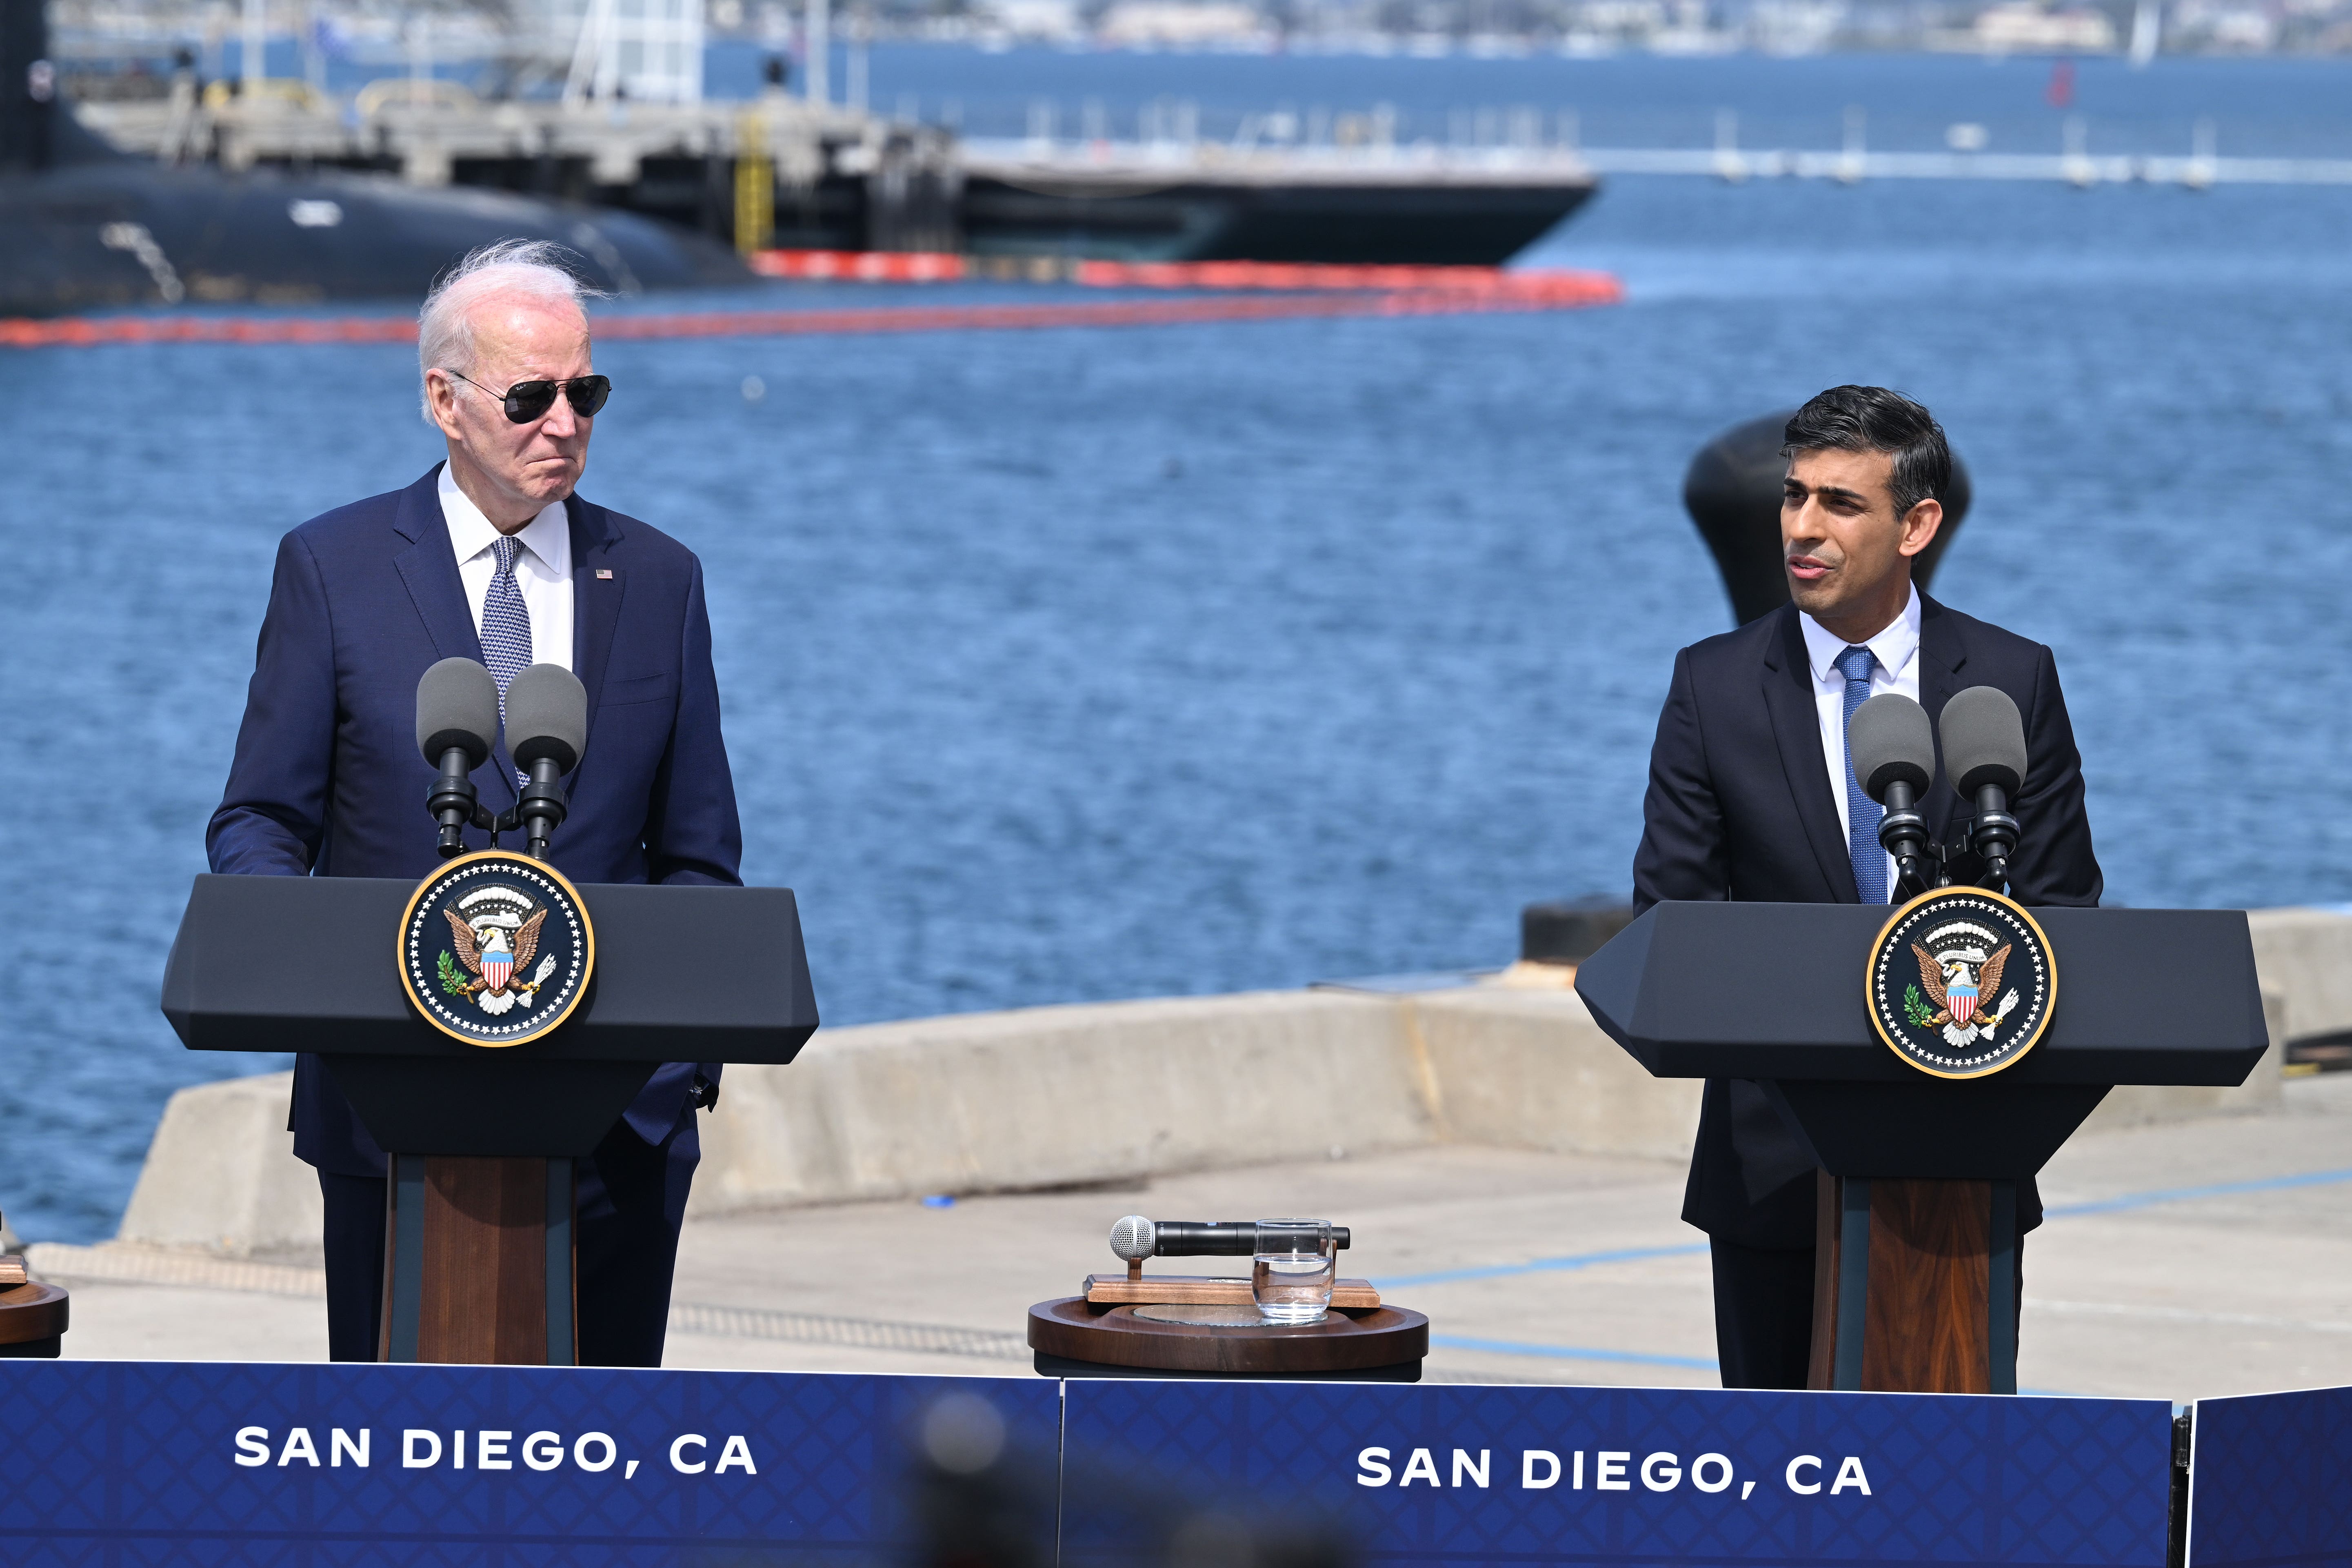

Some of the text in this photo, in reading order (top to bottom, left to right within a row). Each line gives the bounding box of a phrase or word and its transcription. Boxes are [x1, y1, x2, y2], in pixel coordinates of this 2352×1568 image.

[234, 1426, 757, 1480] SAN DIEGO, CA
[1357, 1446, 1872, 1500] SAN DIEGO, CA
